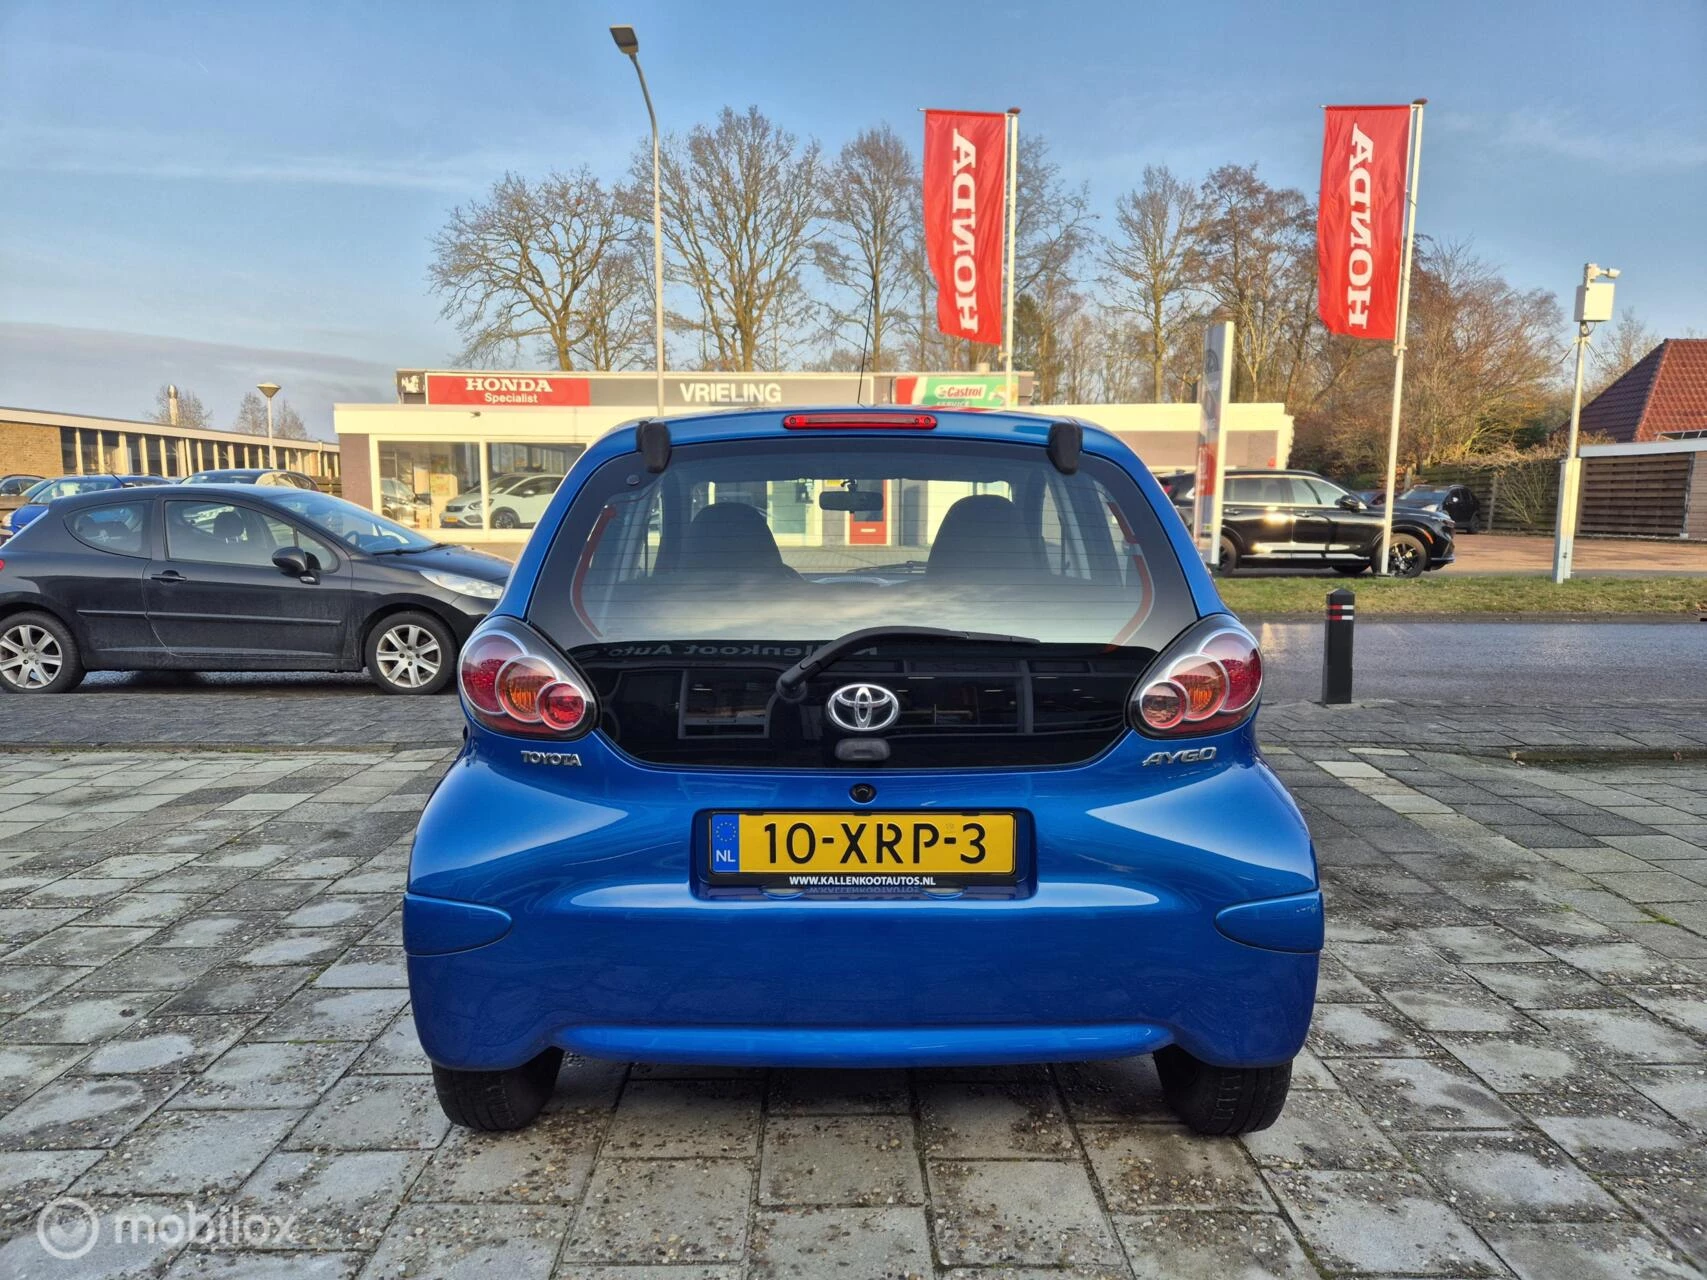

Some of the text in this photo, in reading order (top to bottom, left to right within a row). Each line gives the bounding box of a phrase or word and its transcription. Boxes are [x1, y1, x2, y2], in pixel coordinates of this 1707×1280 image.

[465, 377, 553, 392] HONDA
[947, 386, 983, 398] Castrol
[485, 393, 538, 404] Specialist
[680, 383, 781, 403] VRIELING
[520, 750, 582, 766] TOYOTA
[1142, 746, 1217, 767] AYGO
[763, 822, 987, 865] 10-XRP-3
[715, 849, 736, 863] NL
[788, 875, 936, 887] WWW.KALLENKOOTAUTOS.NL
